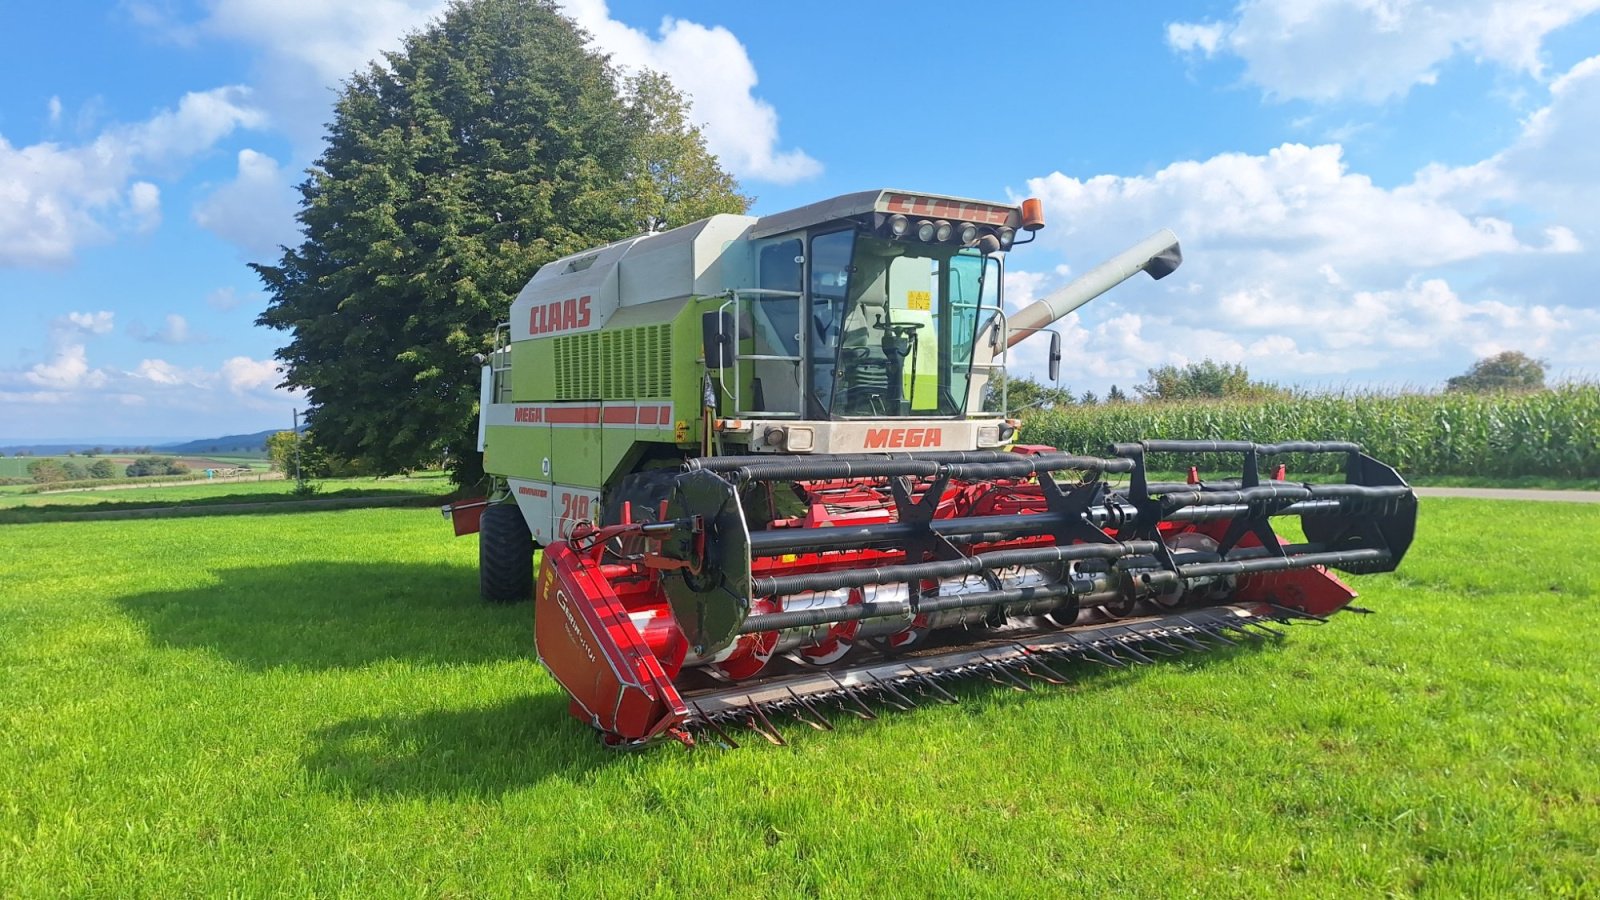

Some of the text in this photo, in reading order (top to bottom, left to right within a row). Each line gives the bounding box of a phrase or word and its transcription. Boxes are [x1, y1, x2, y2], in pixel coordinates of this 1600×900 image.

[887, 194, 1010, 226] CLAAS
[529, 295, 591, 335] CLAAS
[514, 407, 542, 423] MEGA
[863, 428, 942, 448] MEGA
